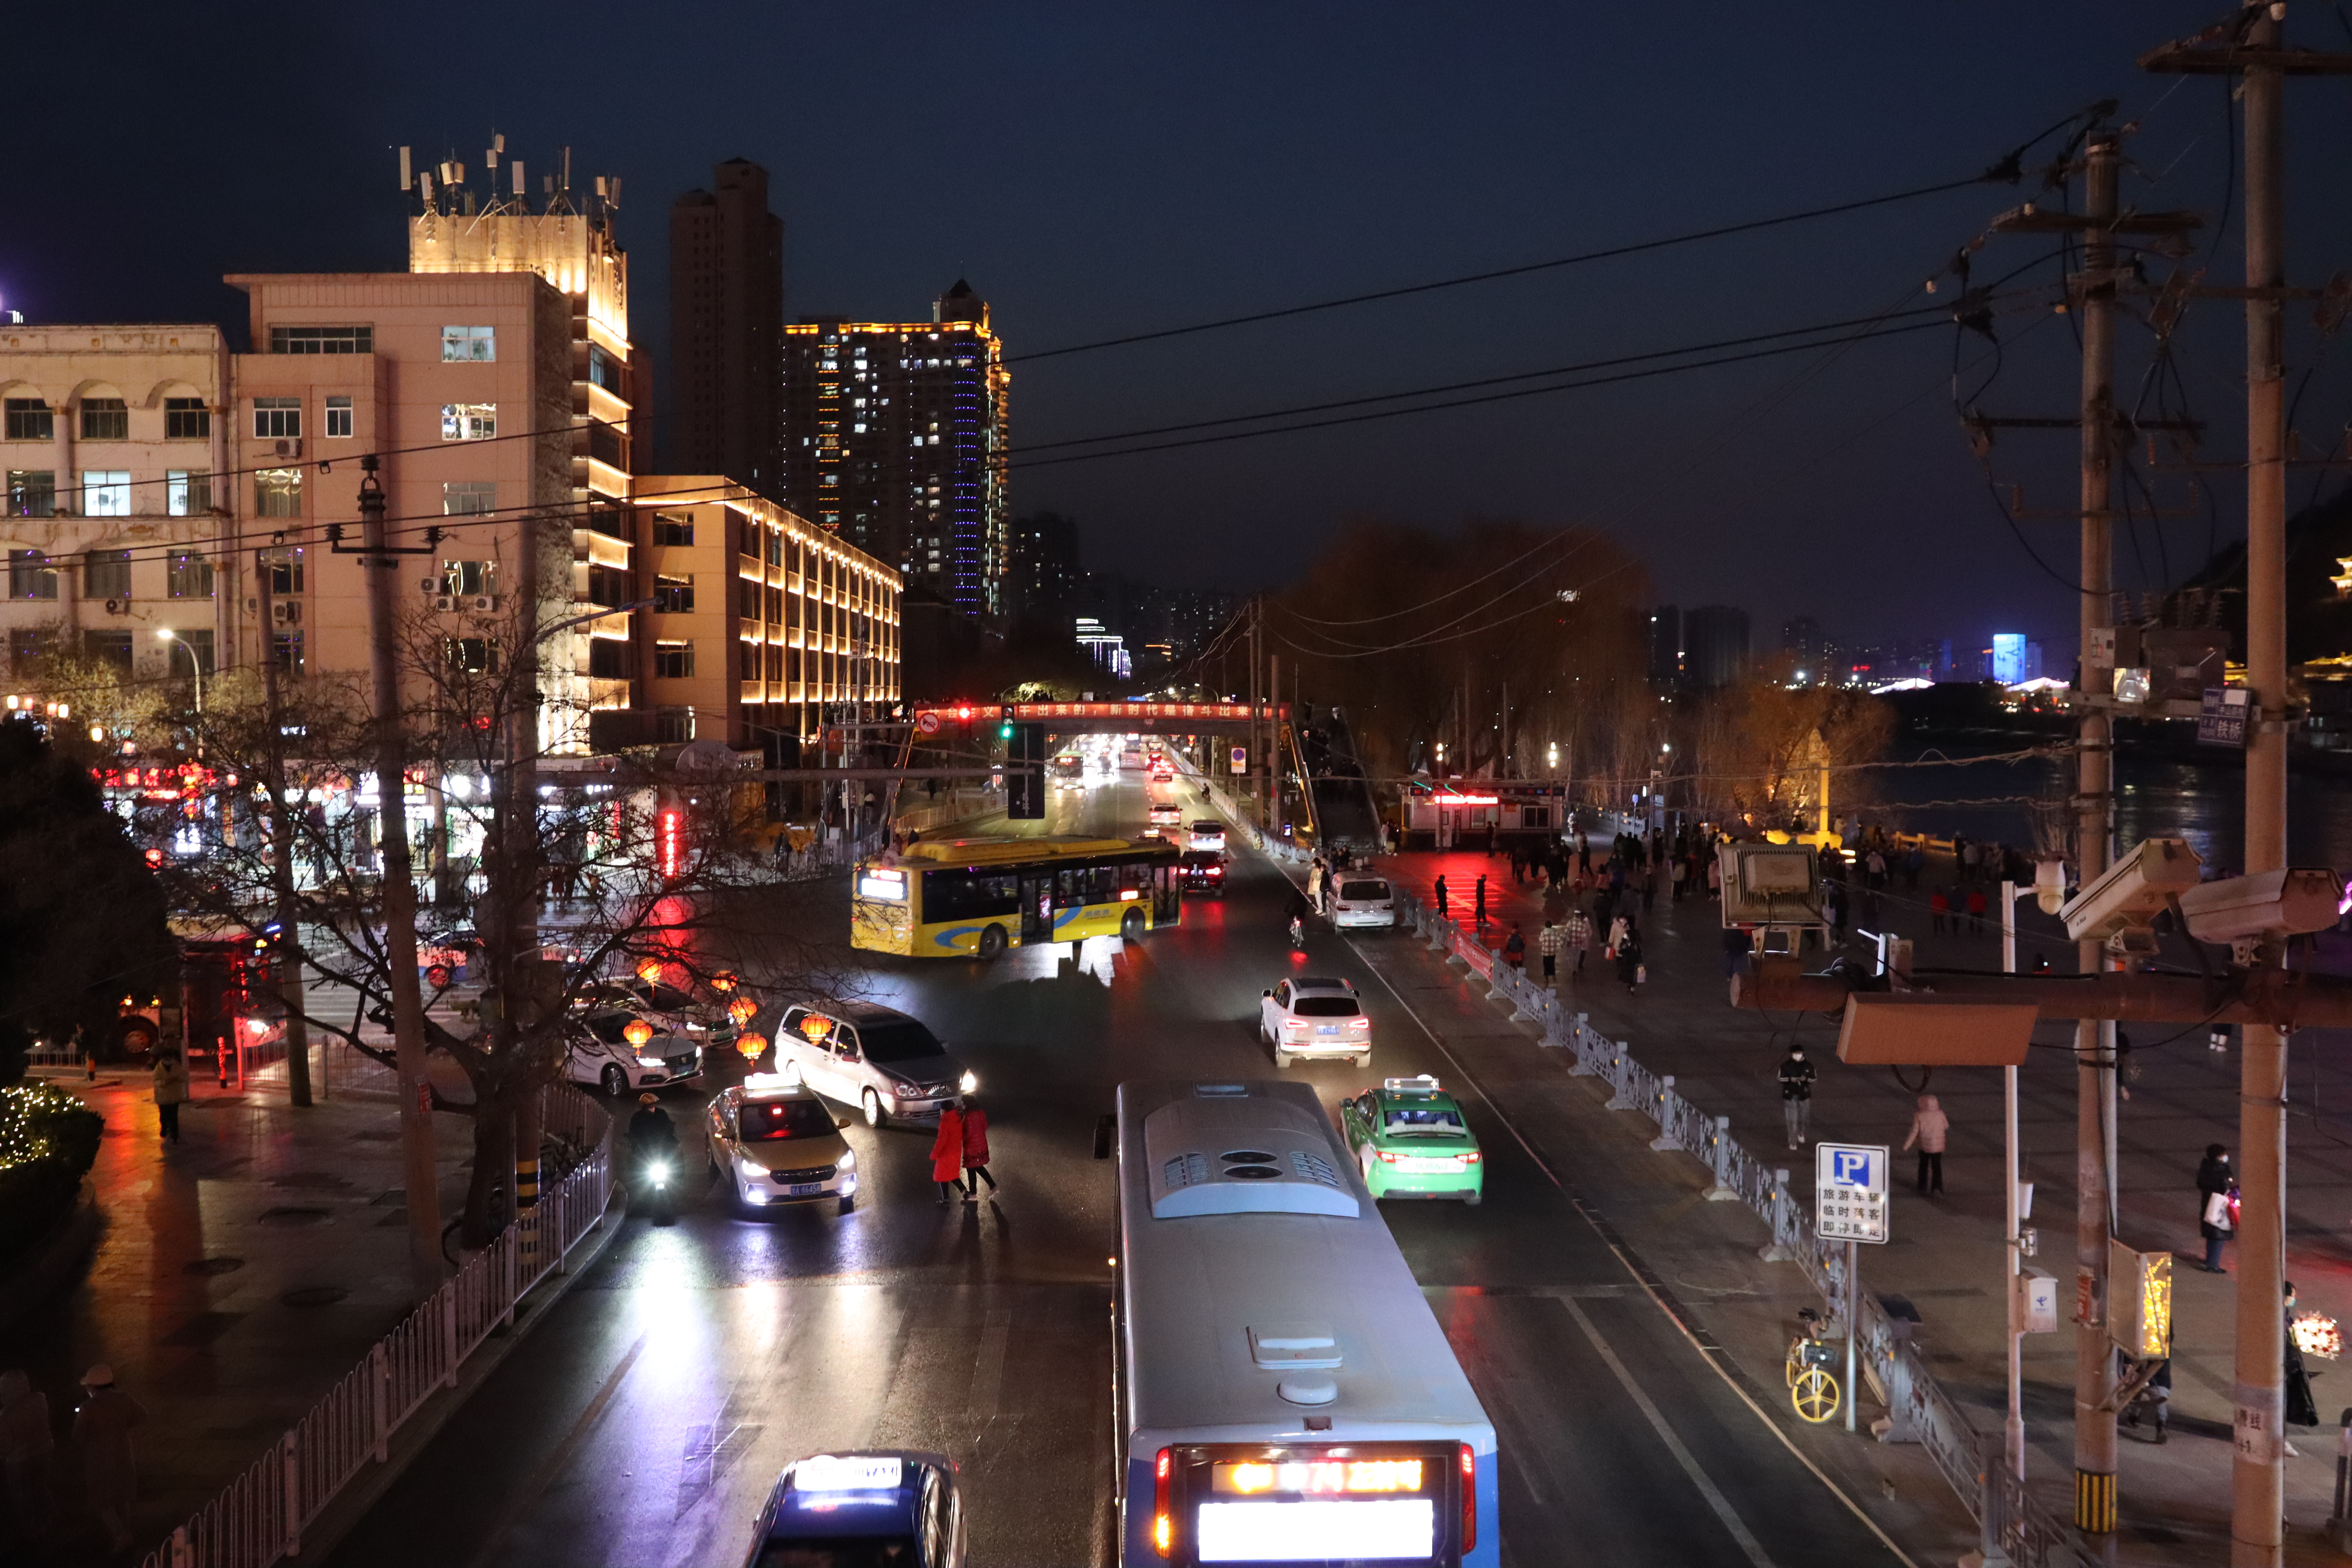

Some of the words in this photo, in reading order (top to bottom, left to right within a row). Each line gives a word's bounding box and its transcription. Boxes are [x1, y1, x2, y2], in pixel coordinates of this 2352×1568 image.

[928, 704, 1267, 718] 社会义干出来的，新时代是奋斗出来
[1838, 1153, 1864, 1184] P
[1823, 1189, 1880, 1203] 旅游车辆
[1823, 1205, 1880, 1220] 临时落客
[1823, 1221, 1880, 1237] 即停即走
[1310, 1462, 1343, 1492] 74
